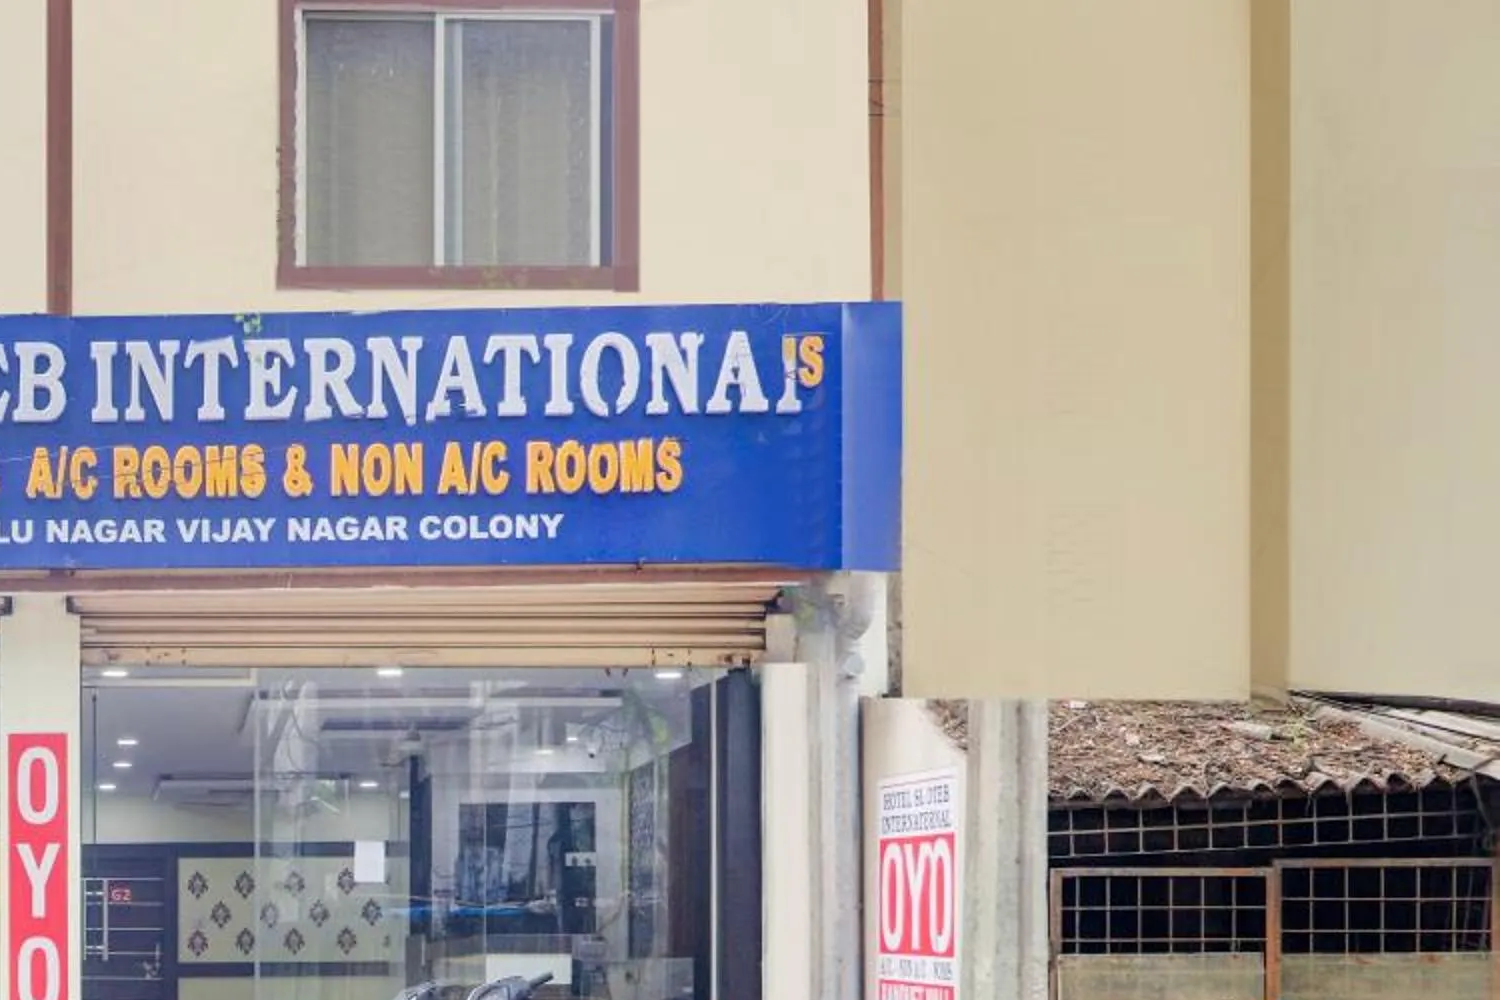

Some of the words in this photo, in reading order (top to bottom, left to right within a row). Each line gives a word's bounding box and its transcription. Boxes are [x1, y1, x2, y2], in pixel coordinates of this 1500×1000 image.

[25, 446, 97, 499] A/C
[113, 445, 267, 499] ROOMS
[283, 444, 313, 497] &
[330, 443, 424, 496] NON
[438, 441, 510, 495] A/C
[526, 438, 683, 494] ROOMS
[45, 518, 166, 544] NAGAR
[175, 517, 276, 543] VIJAY
[286, 515, 408, 542] NAGAR
[418, 513, 564, 541] COLONY
[881, 837, 951, 955] OYO
